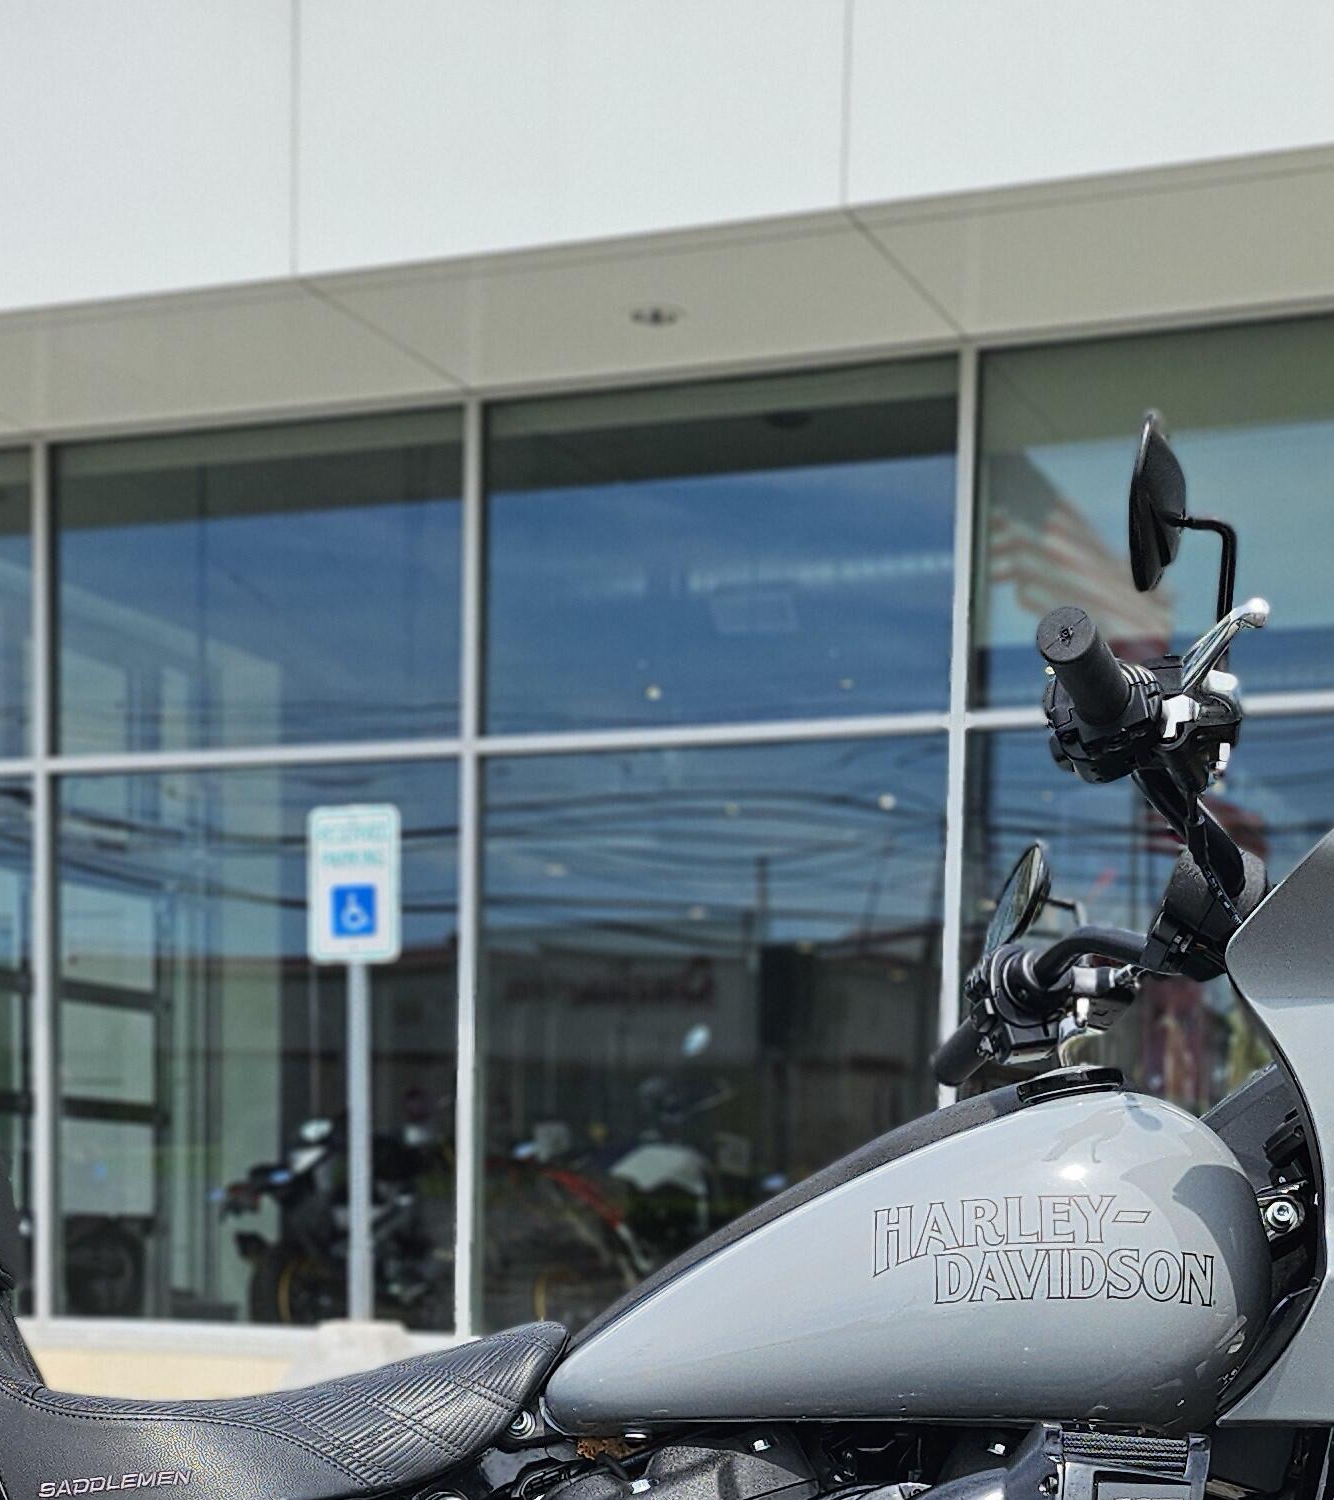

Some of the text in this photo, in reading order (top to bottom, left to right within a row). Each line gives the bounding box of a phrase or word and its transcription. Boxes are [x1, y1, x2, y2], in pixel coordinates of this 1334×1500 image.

[872, 1194, 1152, 1279] HARLEY-
[933, 1247, 1214, 1308] DAVIDSON
[37, 1470, 193, 1499] SADDLEMEN
